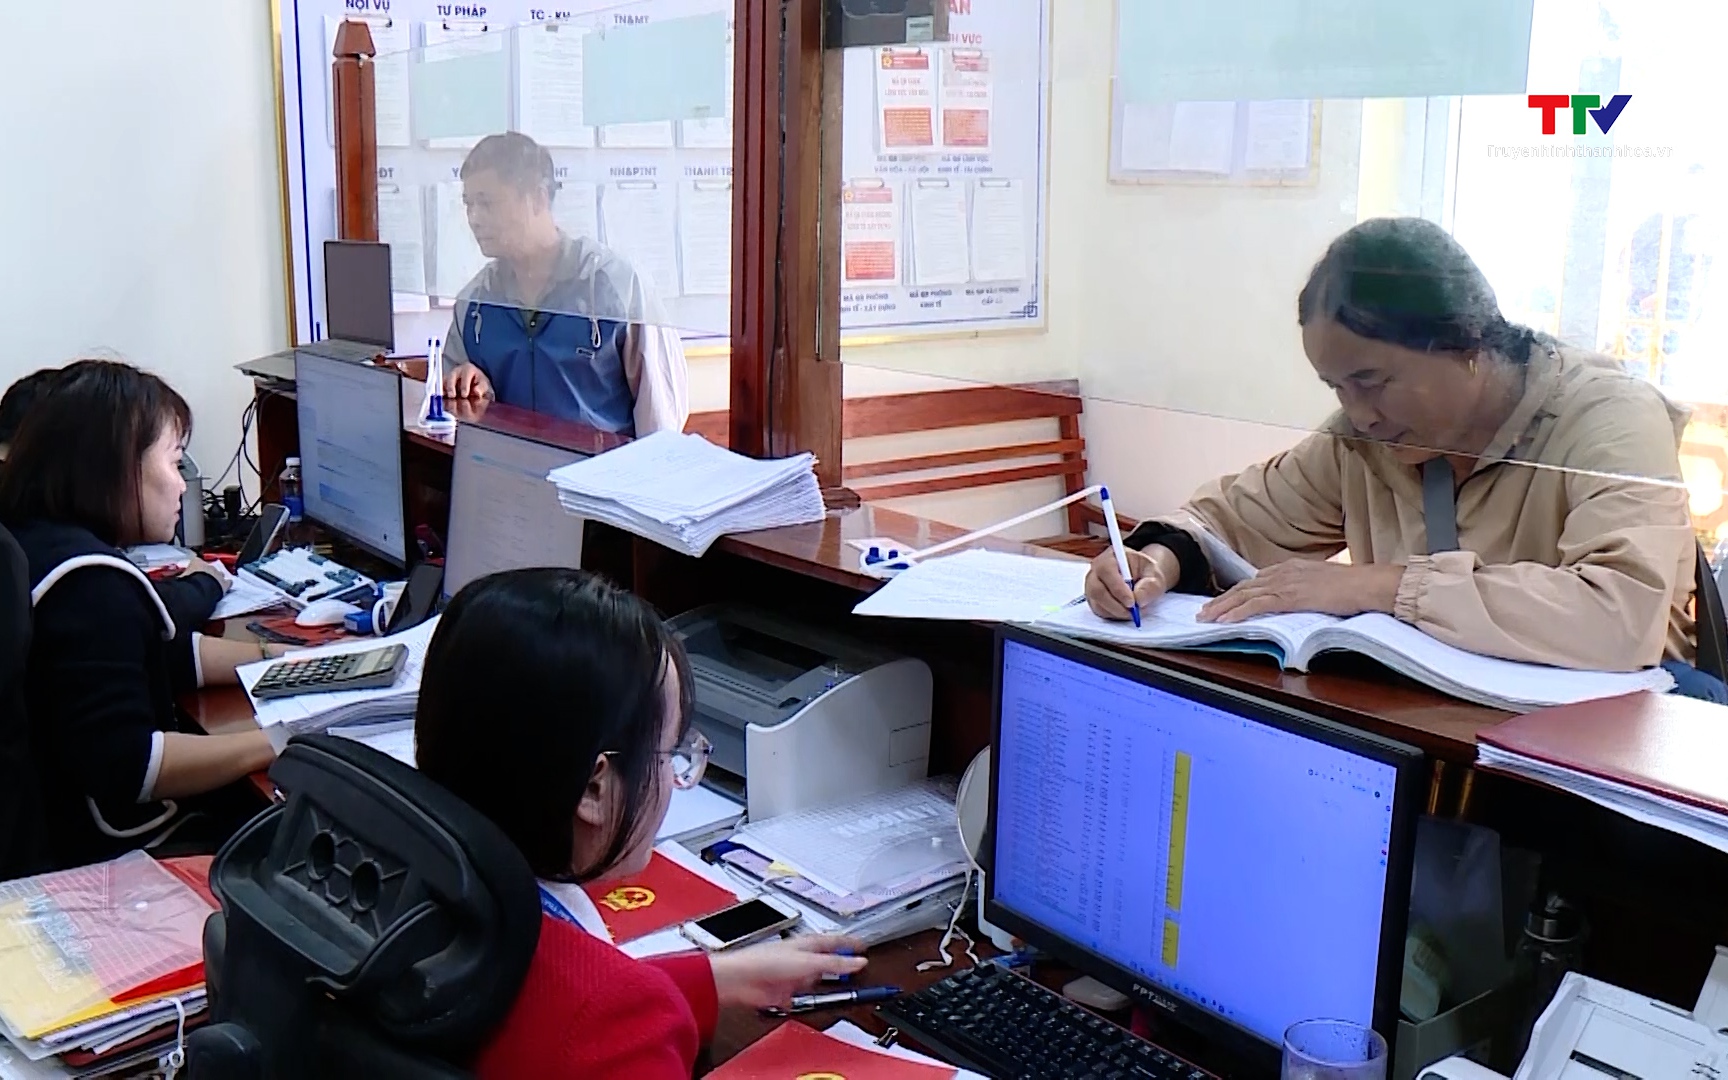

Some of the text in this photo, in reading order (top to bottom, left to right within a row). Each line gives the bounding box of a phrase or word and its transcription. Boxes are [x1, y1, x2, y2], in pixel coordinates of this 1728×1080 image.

[437, 4, 487, 17] TƯ PHÁP
[379, 167, 394, 178] ĐT
